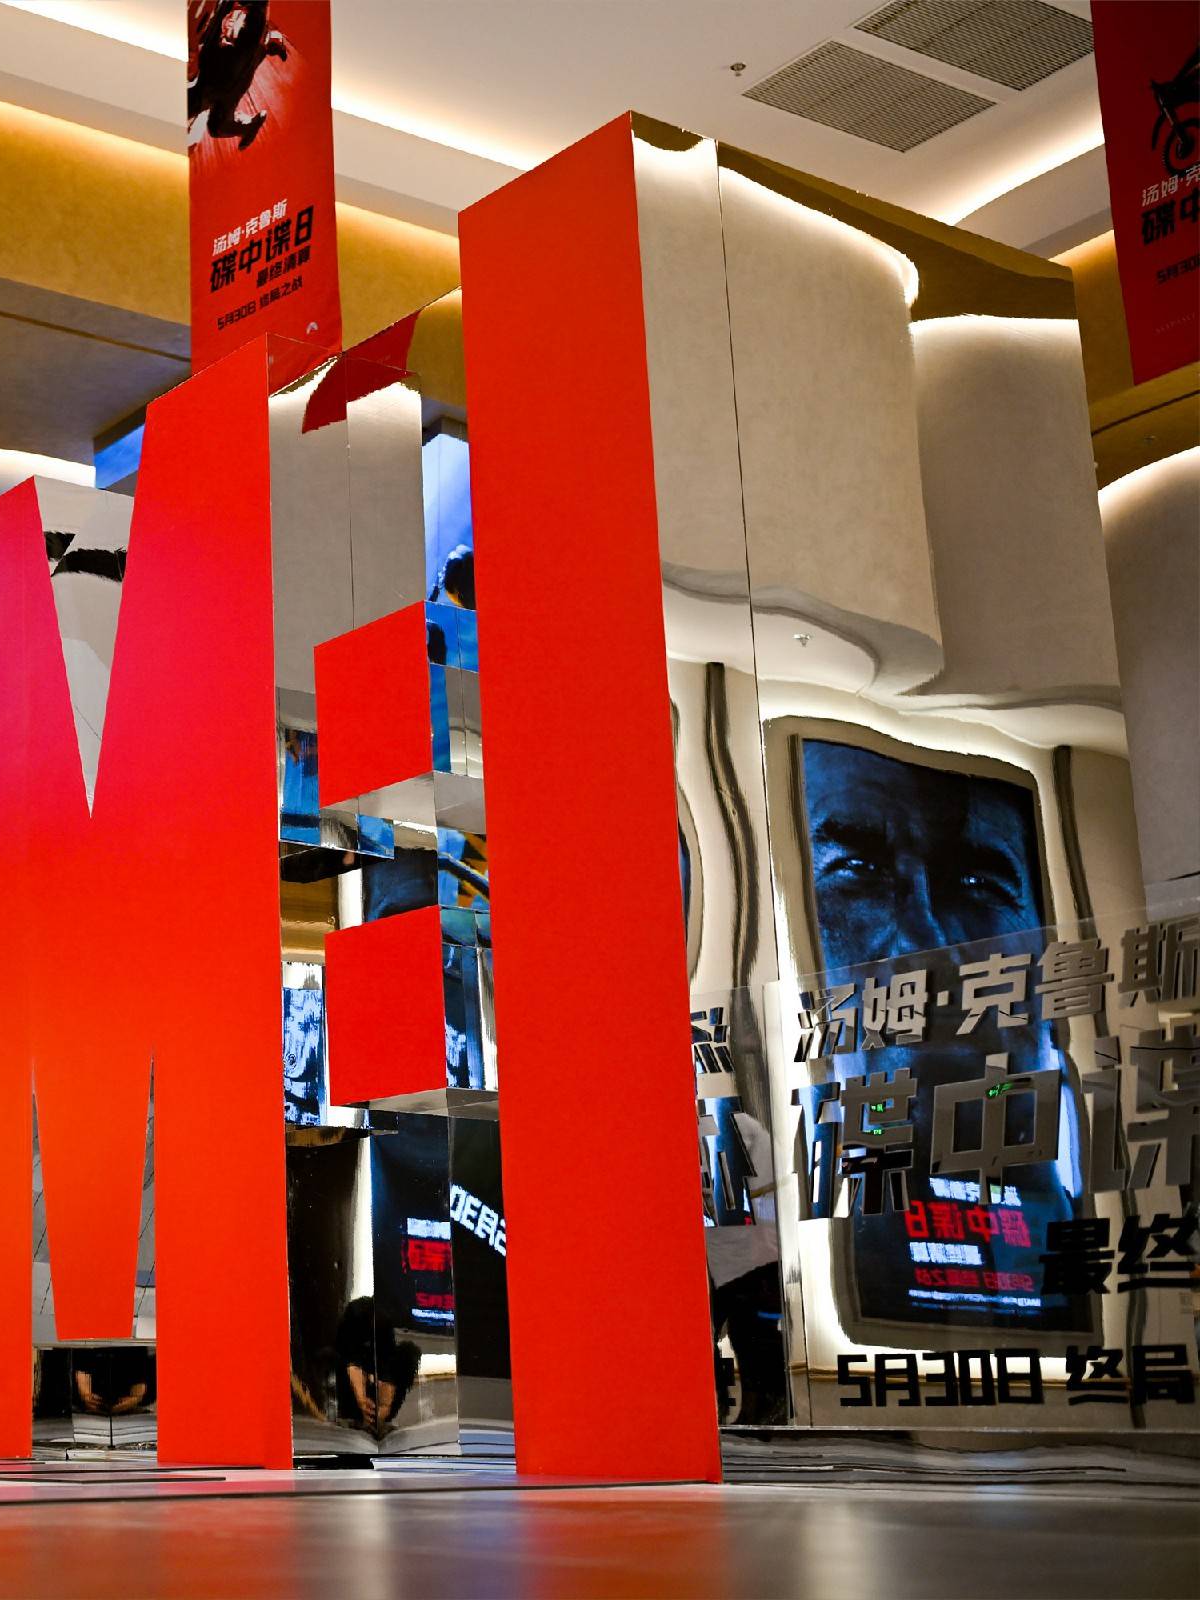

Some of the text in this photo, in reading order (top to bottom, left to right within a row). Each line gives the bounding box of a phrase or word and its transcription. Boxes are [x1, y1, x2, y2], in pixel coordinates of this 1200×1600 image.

[793, 917, 1200, 1063] 汤姆·克鲁斯
[837, 1344, 1195, 1407] 5月30日 终局
